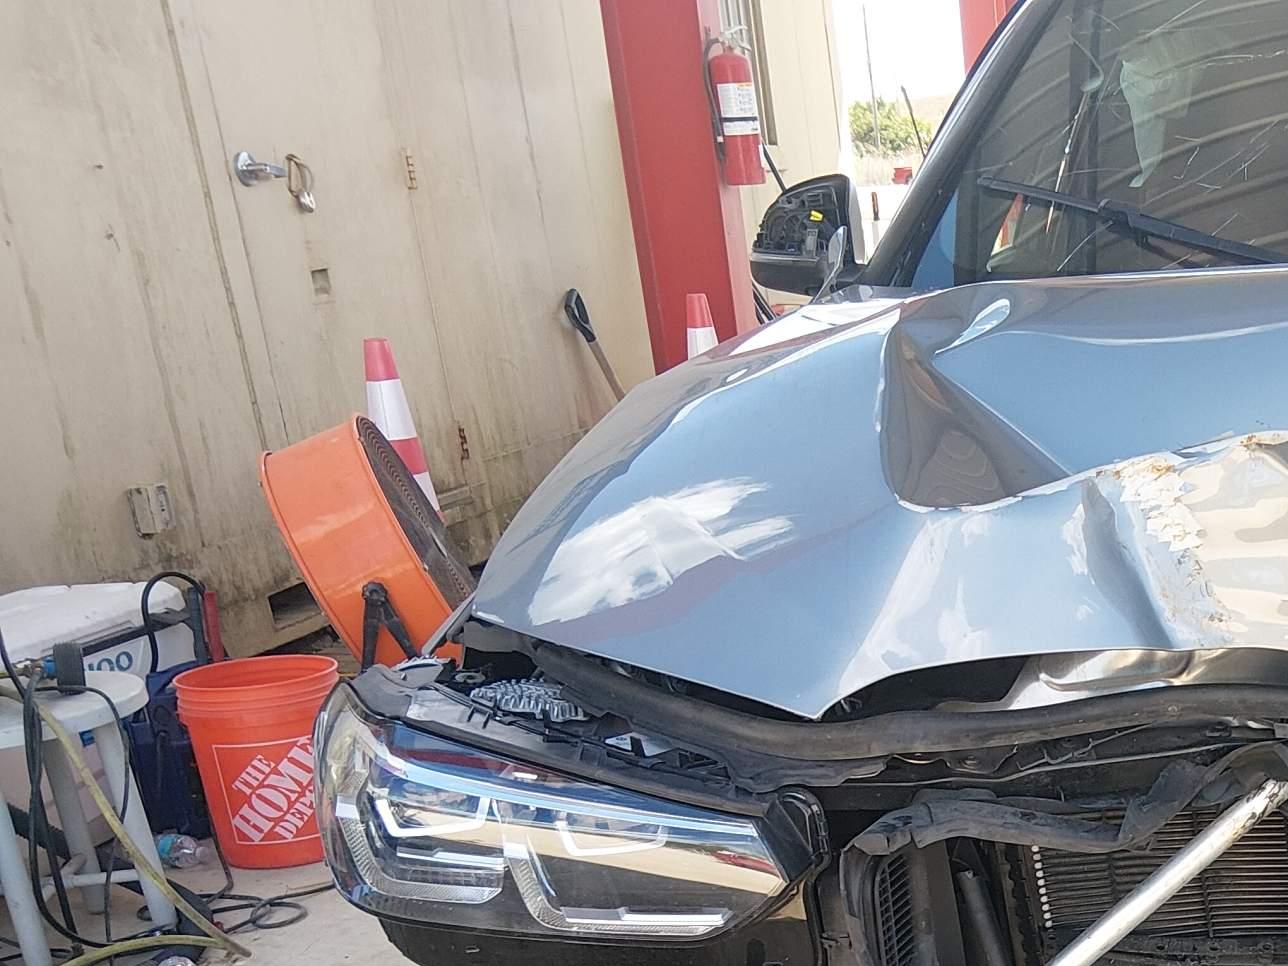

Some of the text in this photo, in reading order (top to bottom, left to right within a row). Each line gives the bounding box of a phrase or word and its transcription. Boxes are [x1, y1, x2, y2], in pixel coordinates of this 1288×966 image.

[232, 754, 276, 796] THE
[233, 738, 315, 842] HOME
[274, 785, 315, 839] DEP
